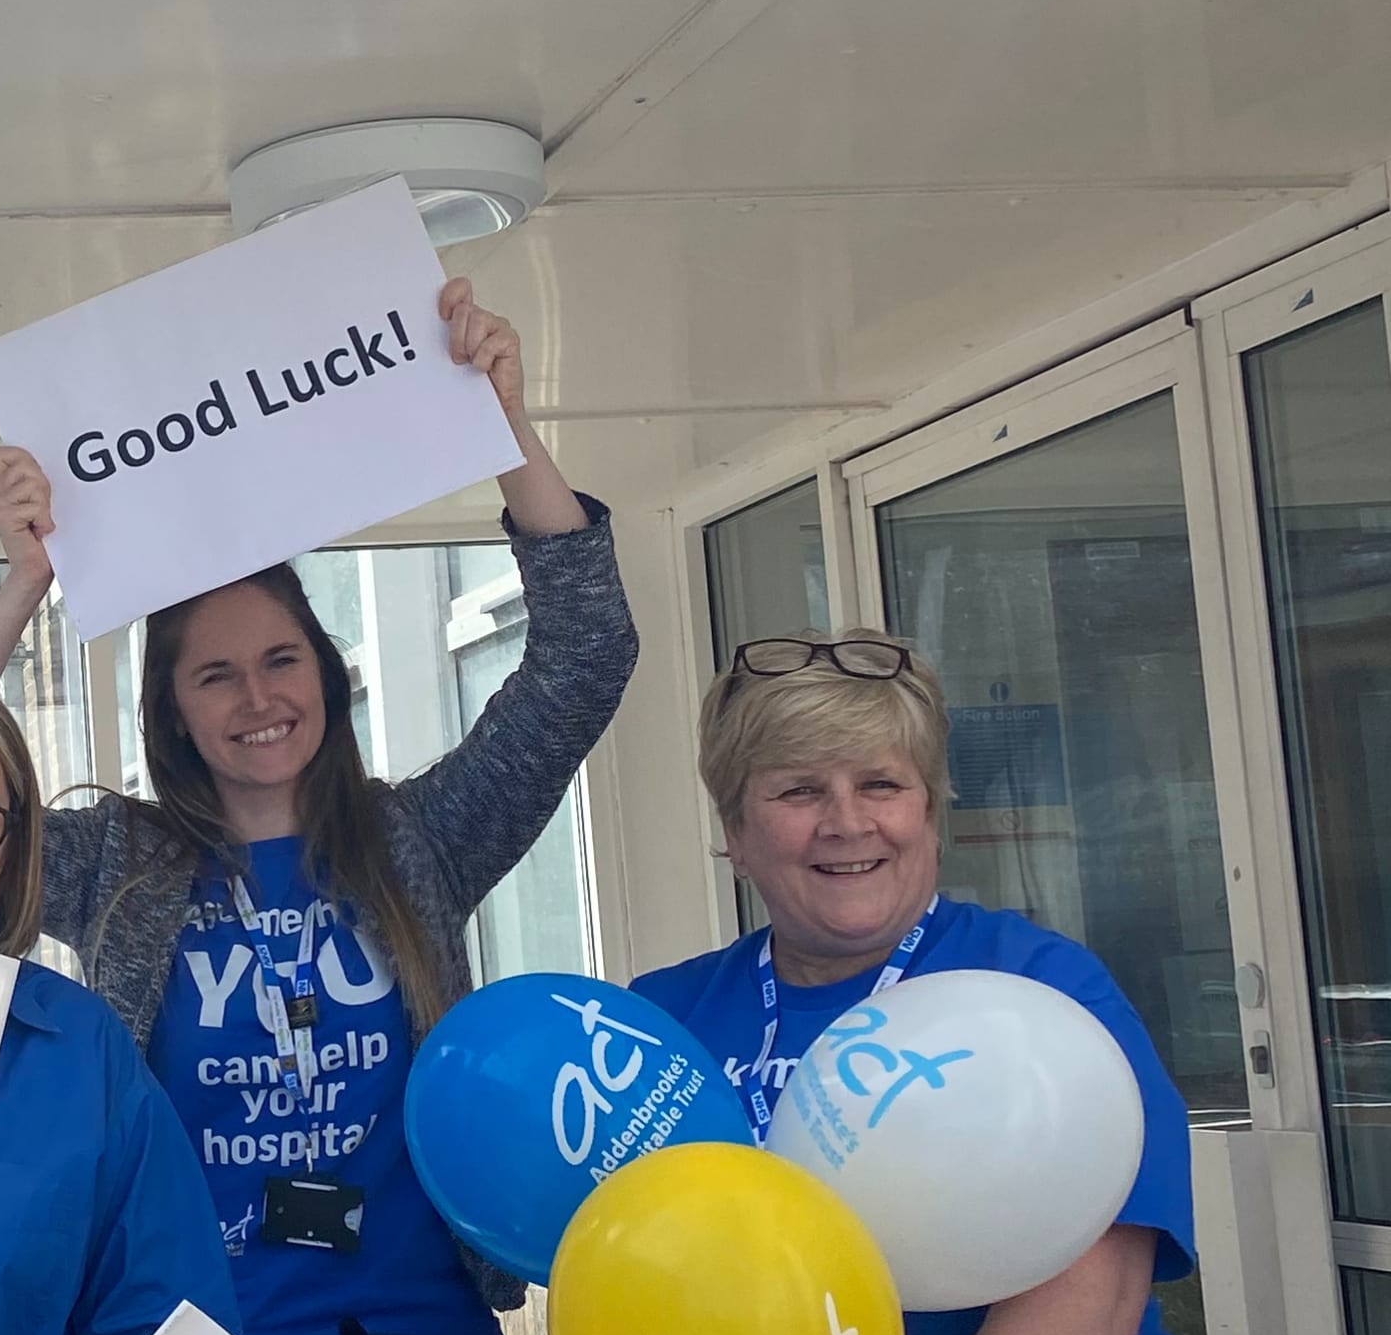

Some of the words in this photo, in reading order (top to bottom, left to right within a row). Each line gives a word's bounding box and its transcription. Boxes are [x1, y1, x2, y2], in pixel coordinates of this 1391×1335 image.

[67, 379, 238, 483] Good
[246, 310, 417, 416] Luck!
[902, 927, 922, 953] NHS
[764, 981, 776, 1007] NHS
[197, 1055, 281, 1086] can
[550, 993, 663, 1166] act
[752, 1092, 769, 1123] NHS
[824, 1006, 975, 1129] act
[589, 1054, 689, 1185] Addenbrooke's
[638, 1106, 683, 1158] itable
[672, 1068, 707, 1108] Trust
